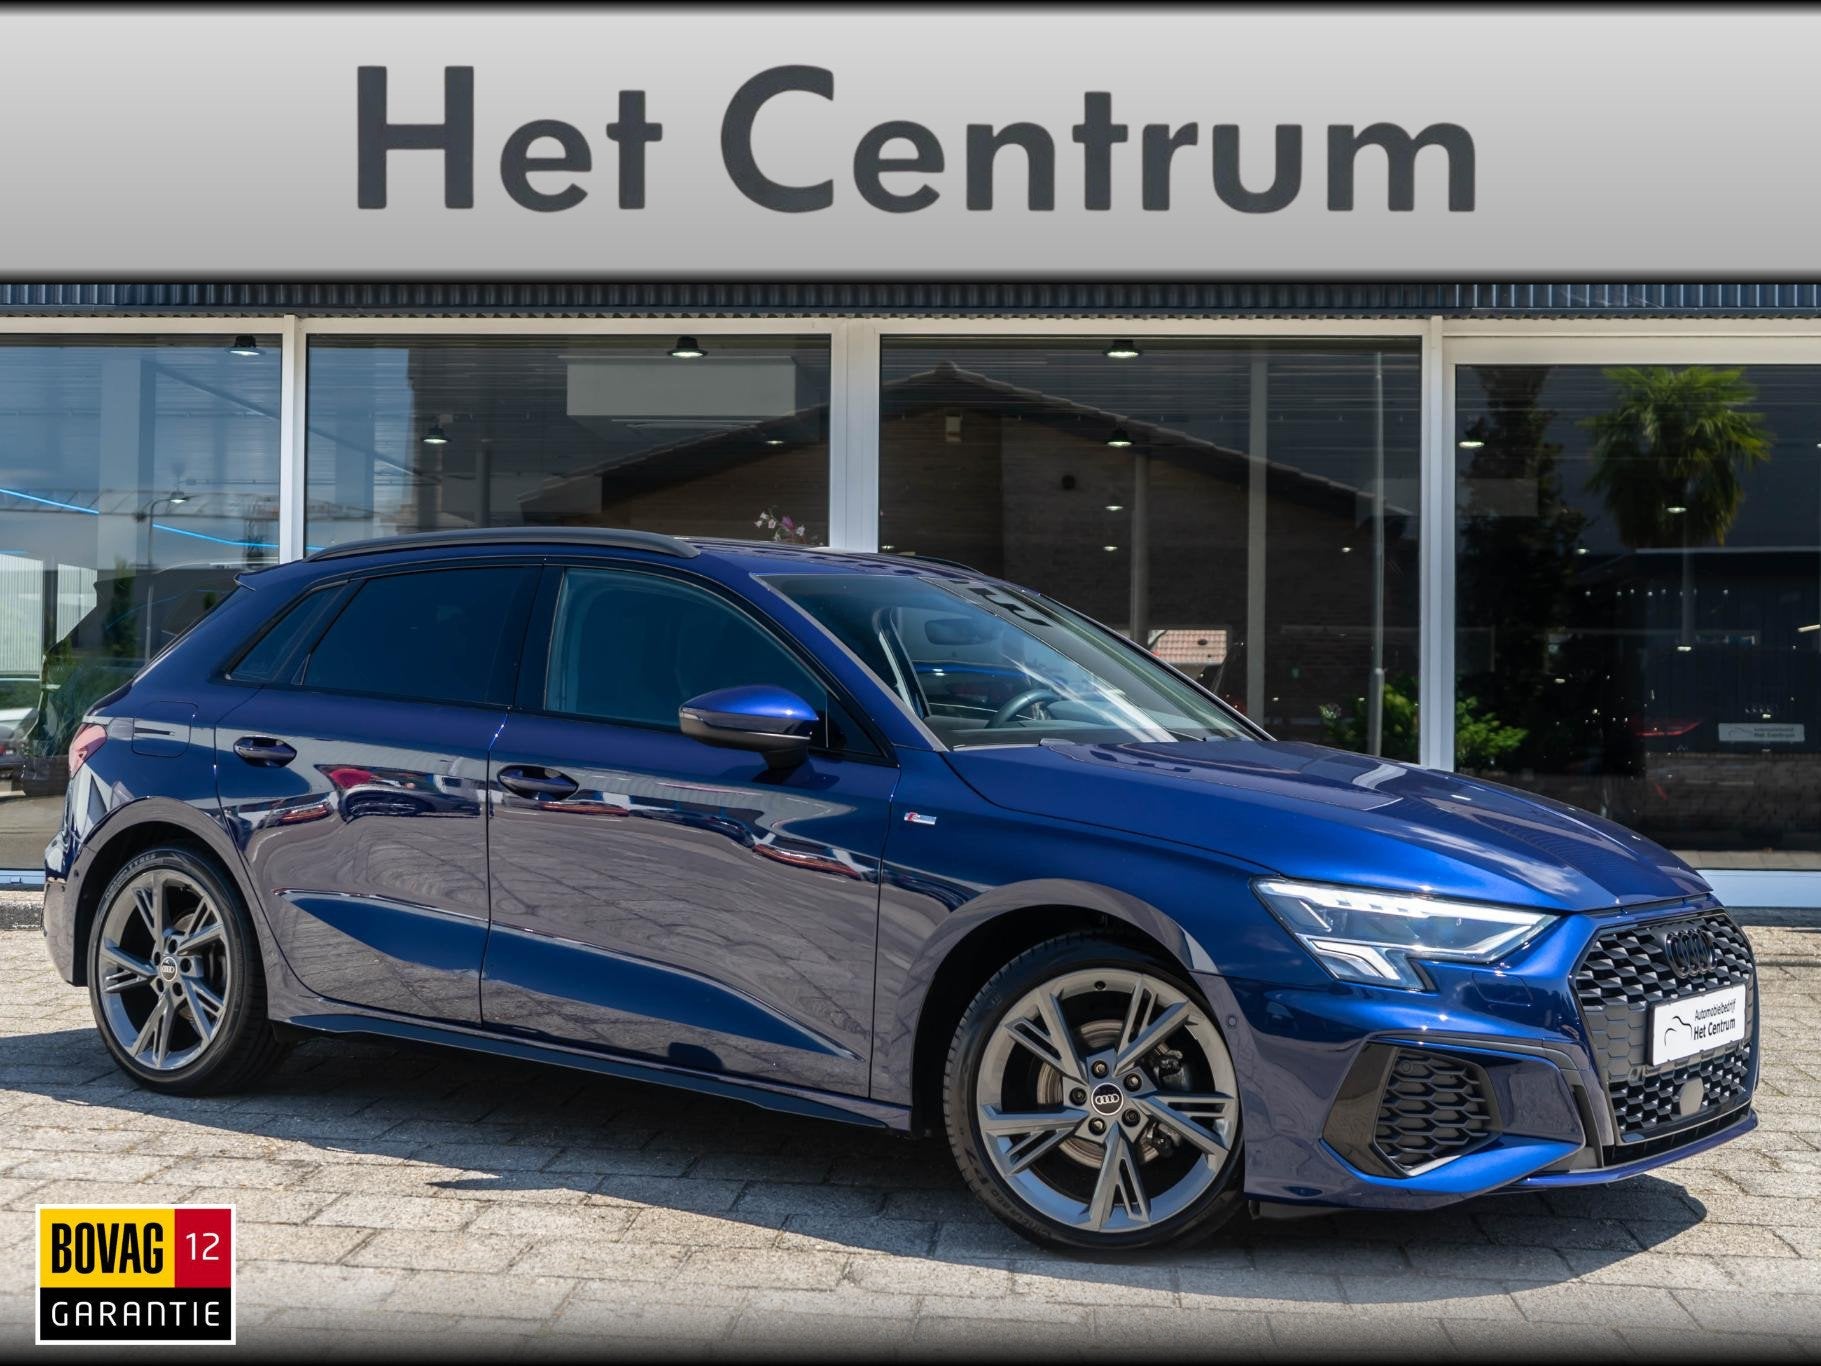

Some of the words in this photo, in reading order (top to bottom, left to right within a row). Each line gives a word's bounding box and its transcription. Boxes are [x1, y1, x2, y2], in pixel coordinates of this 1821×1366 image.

[1694, 999, 1737, 1021] Automobielbedrijf
[1693, 1023, 1706, 1040] Het
[1707, 1018, 1736, 1036] Centrum
